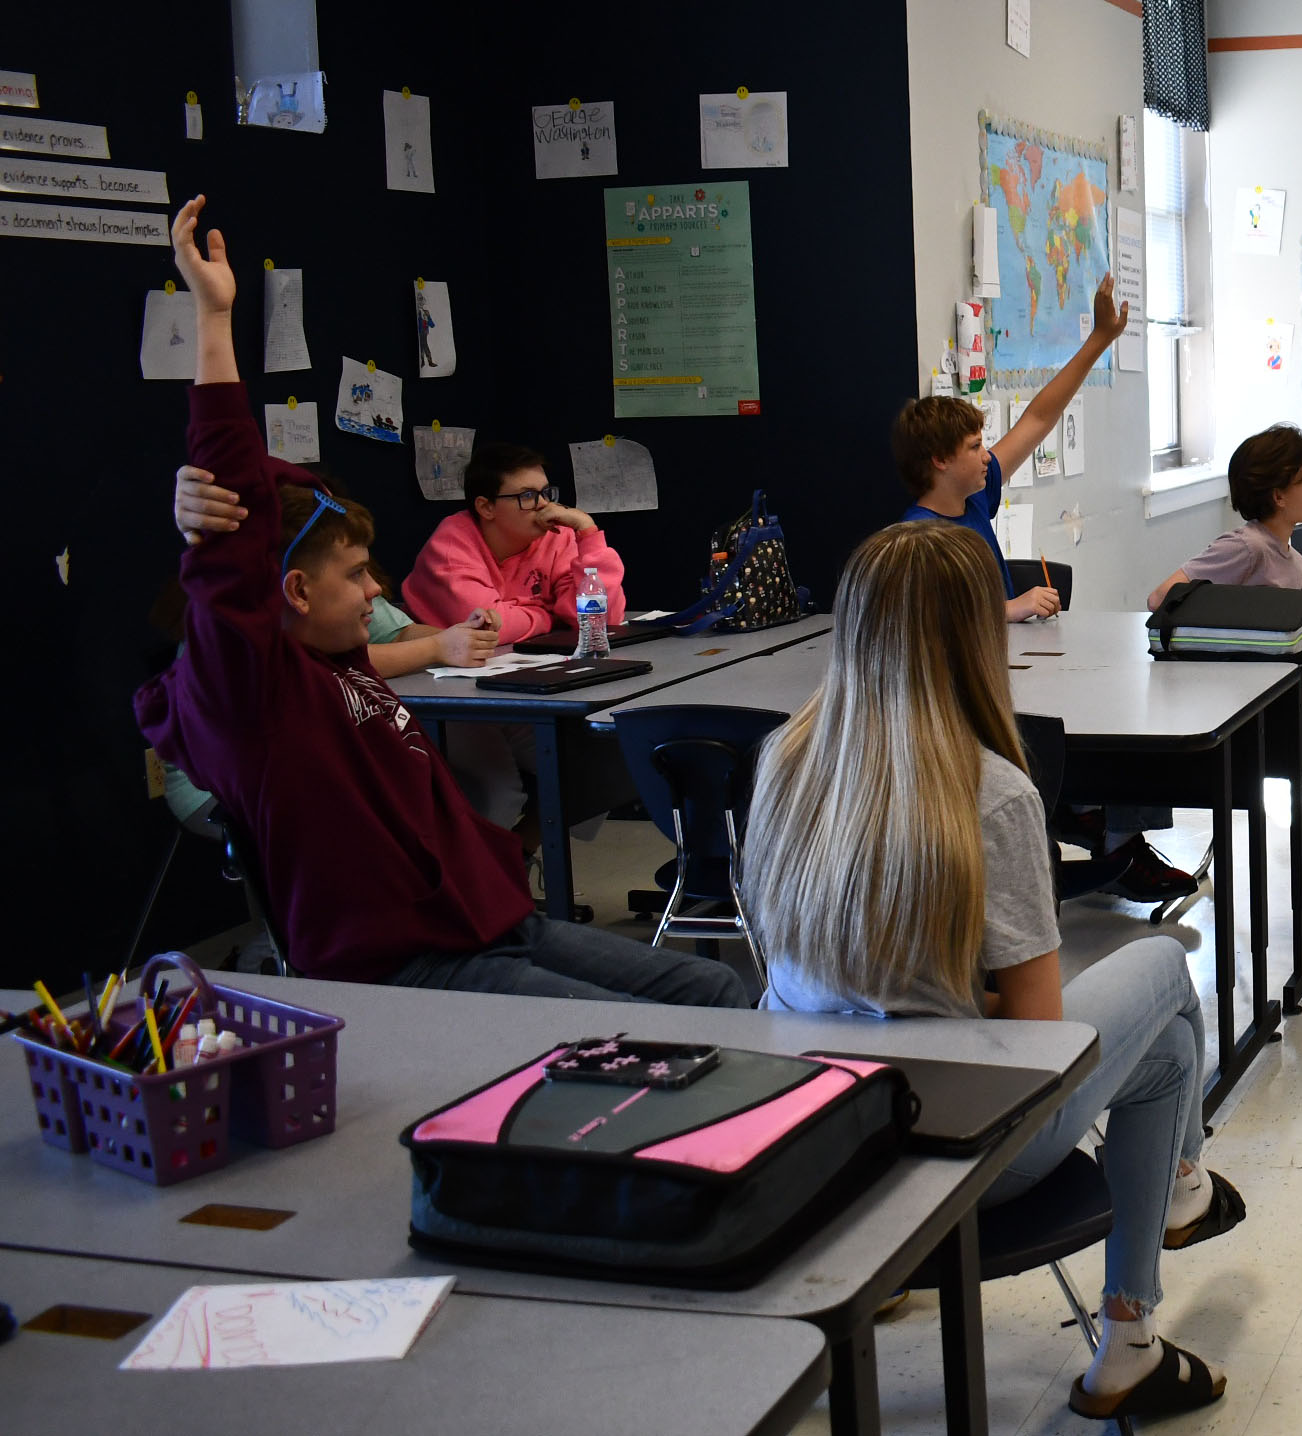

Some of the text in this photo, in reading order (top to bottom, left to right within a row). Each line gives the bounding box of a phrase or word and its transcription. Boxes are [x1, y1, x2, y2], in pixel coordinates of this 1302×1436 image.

[3, 128, 45, 145] evidence
[3, 171, 48, 187] evidence
[637, 203, 719, 221] APPARTS
[13, 213, 63, 231] document
